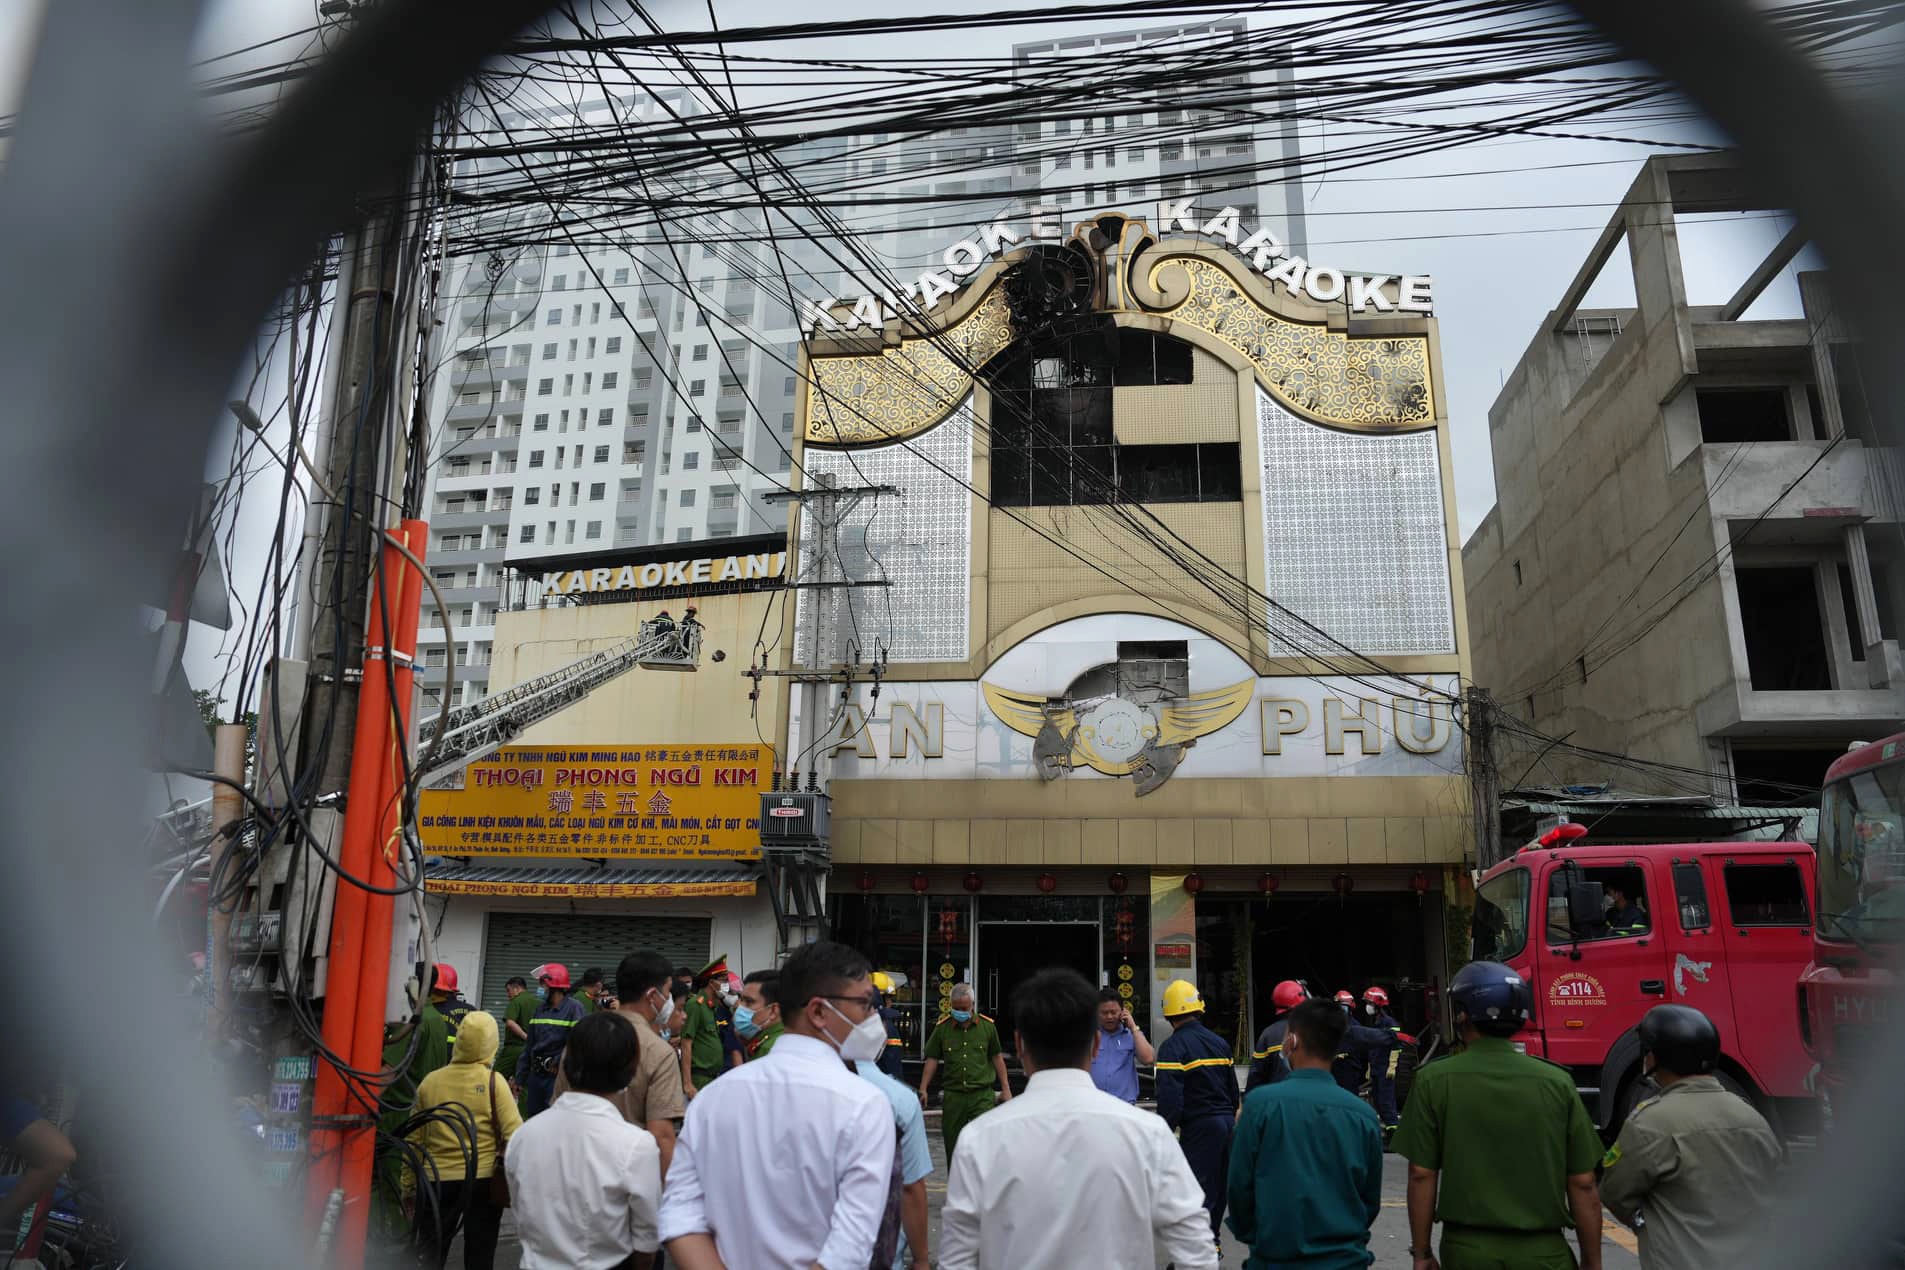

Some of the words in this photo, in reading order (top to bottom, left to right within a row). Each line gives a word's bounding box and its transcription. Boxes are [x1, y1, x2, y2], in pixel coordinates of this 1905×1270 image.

[1158, 198, 1434, 313] KARAOKE
[542, 558, 712, 596] KARAOKE
[828, 703, 944, 758] AN
[1261, 674, 1451, 755] PHÚ
[504, 752, 514, 762] TY
[518, 752, 543, 762] TNHH
[569, 752, 588, 762] KIM
[591, 752, 617, 762] MING
[621, 752, 641, 762] HAO
[473, 768, 544, 791] THOẠI
[555, 767, 637, 787] PHONG
[650, 765, 701, 786] NGŨ
[713, 767, 758, 786] KIM
[547, 789, 673, 816] 瑞丰五金
[422, 816, 434, 827] GIA
[608, 817, 624, 828] KIM
[464, 883, 508, 893] PHONG
[543, 885, 569, 895] KIM
[1570, 982, 1592, 995] 114
